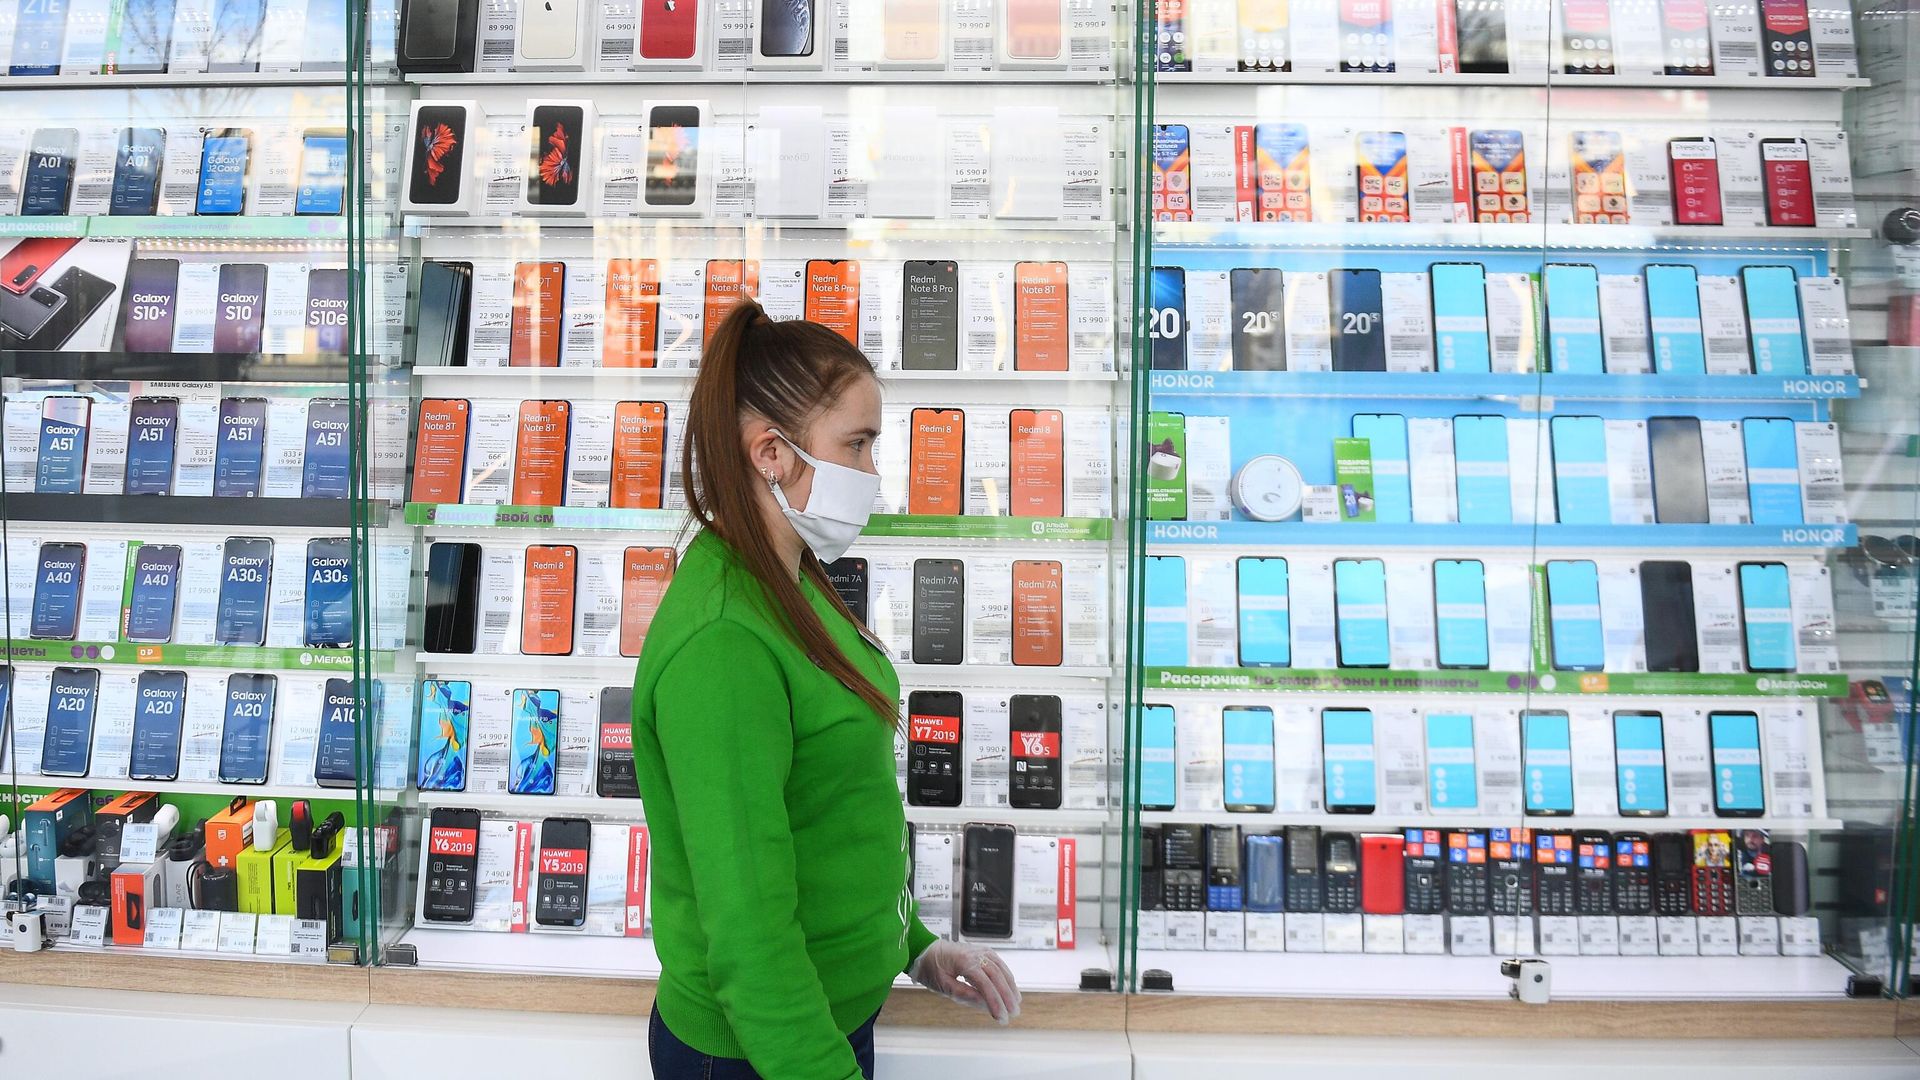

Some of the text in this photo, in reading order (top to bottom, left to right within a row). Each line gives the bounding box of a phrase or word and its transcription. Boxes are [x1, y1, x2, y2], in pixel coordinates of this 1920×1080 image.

[36, 146, 68, 154] Galaxy
[122, 145, 155, 154] Galaxy
[38, 157, 61, 168] A01
[125, 156, 148, 167] A01
[207, 156, 240, 166] Galaxy
[711, 284, 729, 292] Note
[740, 284, 754, 292] Pro
[812, 284, 855, 292] Note 8 Pro
[911, 284, 953, 292] Note 8 Pro
[1044, 286, 1055, 294] 8T
[133, 294, 170, 305] Galaxy
[221, 293, 259, 305] Galaxy
[310, 298, 348, 310] Galaxy
[133, 306, 167, 320] S10+
[225, 306, 251, 320] S10
[310, 310, 348, 325] S10e
[1152, 375, 1214, 388] HONOR
[1784, 381, 1846, 393] HONOR
[135, 416, 170, 427] Galaxy
[224, 416, 259, 427] Galaxy
[424, 413, 450, 422] Redmi
[524, 414, 550, 423] Redmi
[620, 415, 646, 424] Redmi
[46, 426, 80, 437] Galaxy
[312, 421, 349, 432] Galaxy
[424, 422, 456, 431] Note 8T
[524, 423, 556, 432] Note 8T
[620, 425, 653, 433] Note 8T
[920, 424, 944, 433] Redmi
[139, 428, 164, 441] A51
[227, 428, 253, 440] A51
[316, 432, 342, 446] A51
[49, 438, 73, 450] A51
[495, 508, 529, 523] свой
[1155, 525, 1217, 538] HONOR
[1783, 530, 1844, 542] HONOR
[44, 561, 76, 572] Galaxy
[142, 562, 173, 573] Galaxy
[229, 557, 264, 567] Galaxy
[312, 557, 348, 569] Galaxy
[533, 561, 564, 570] Redmi 8
[631, 563, 664, 571] Redmi 8A
[46, 572, 72, 583] A40
[142, 574, 169, 586] A40
[228, 569, 262, 582] A30s
[312, 569, 348, 583] A30s
[851, 574, 862, 583] 7A
[920, 576, 958, 584] Redmi 7A
[1018, 580, 1057, 589] Redmi 7A
[1161, 671, 1249, 687] Рассрочка
[56, 685, 90, 697] Galaxy
[143, 689, 177, 700] Galaxy
[231, 691, 266, 703] Galaxy
[58, 697, 84, 711] A20
[145, 701, 173, 714] A20
[233, 704, 262, 717] A20
[914, 727, 955, 741] Y7 2019
[435, 838, 472, 852] Y6 2019
[544, 859, 584, 873] Y5 2019
